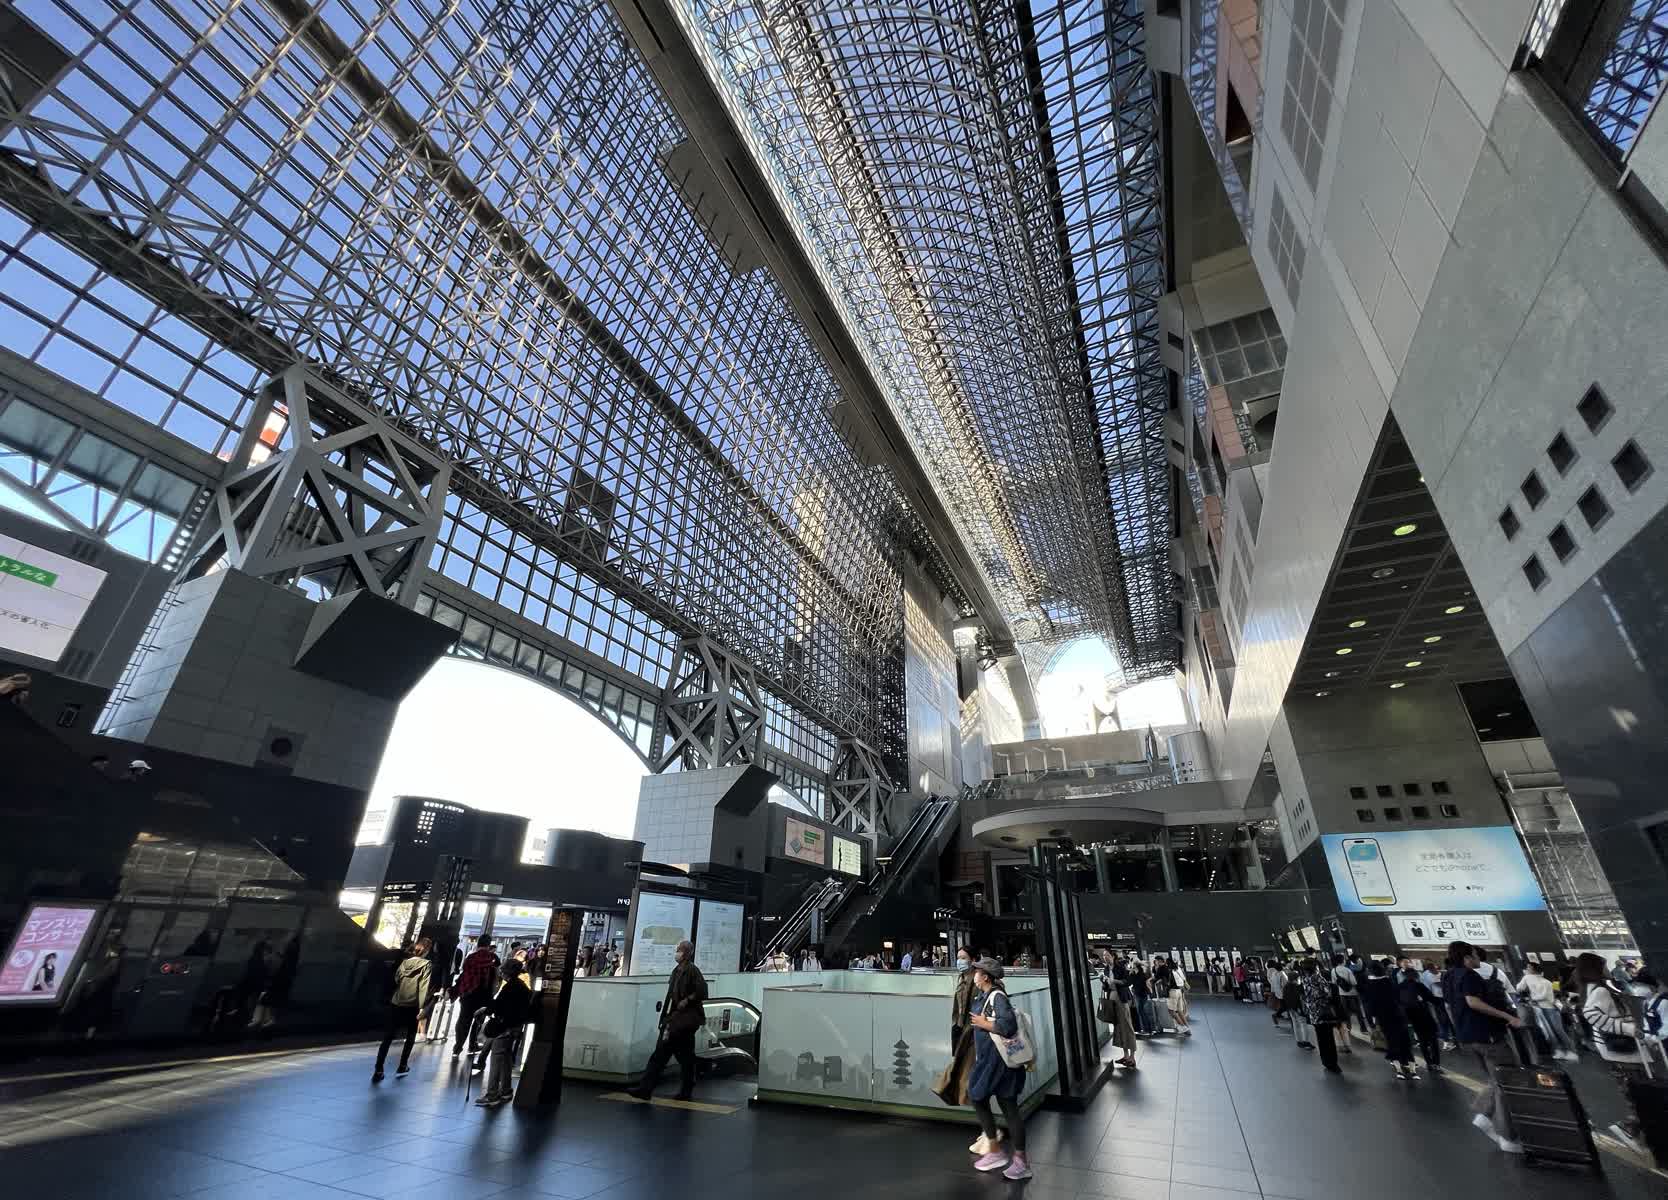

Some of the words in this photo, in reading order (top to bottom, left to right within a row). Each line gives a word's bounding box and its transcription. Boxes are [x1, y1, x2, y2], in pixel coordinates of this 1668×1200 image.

[23, 928, 82, 943] コンサート
